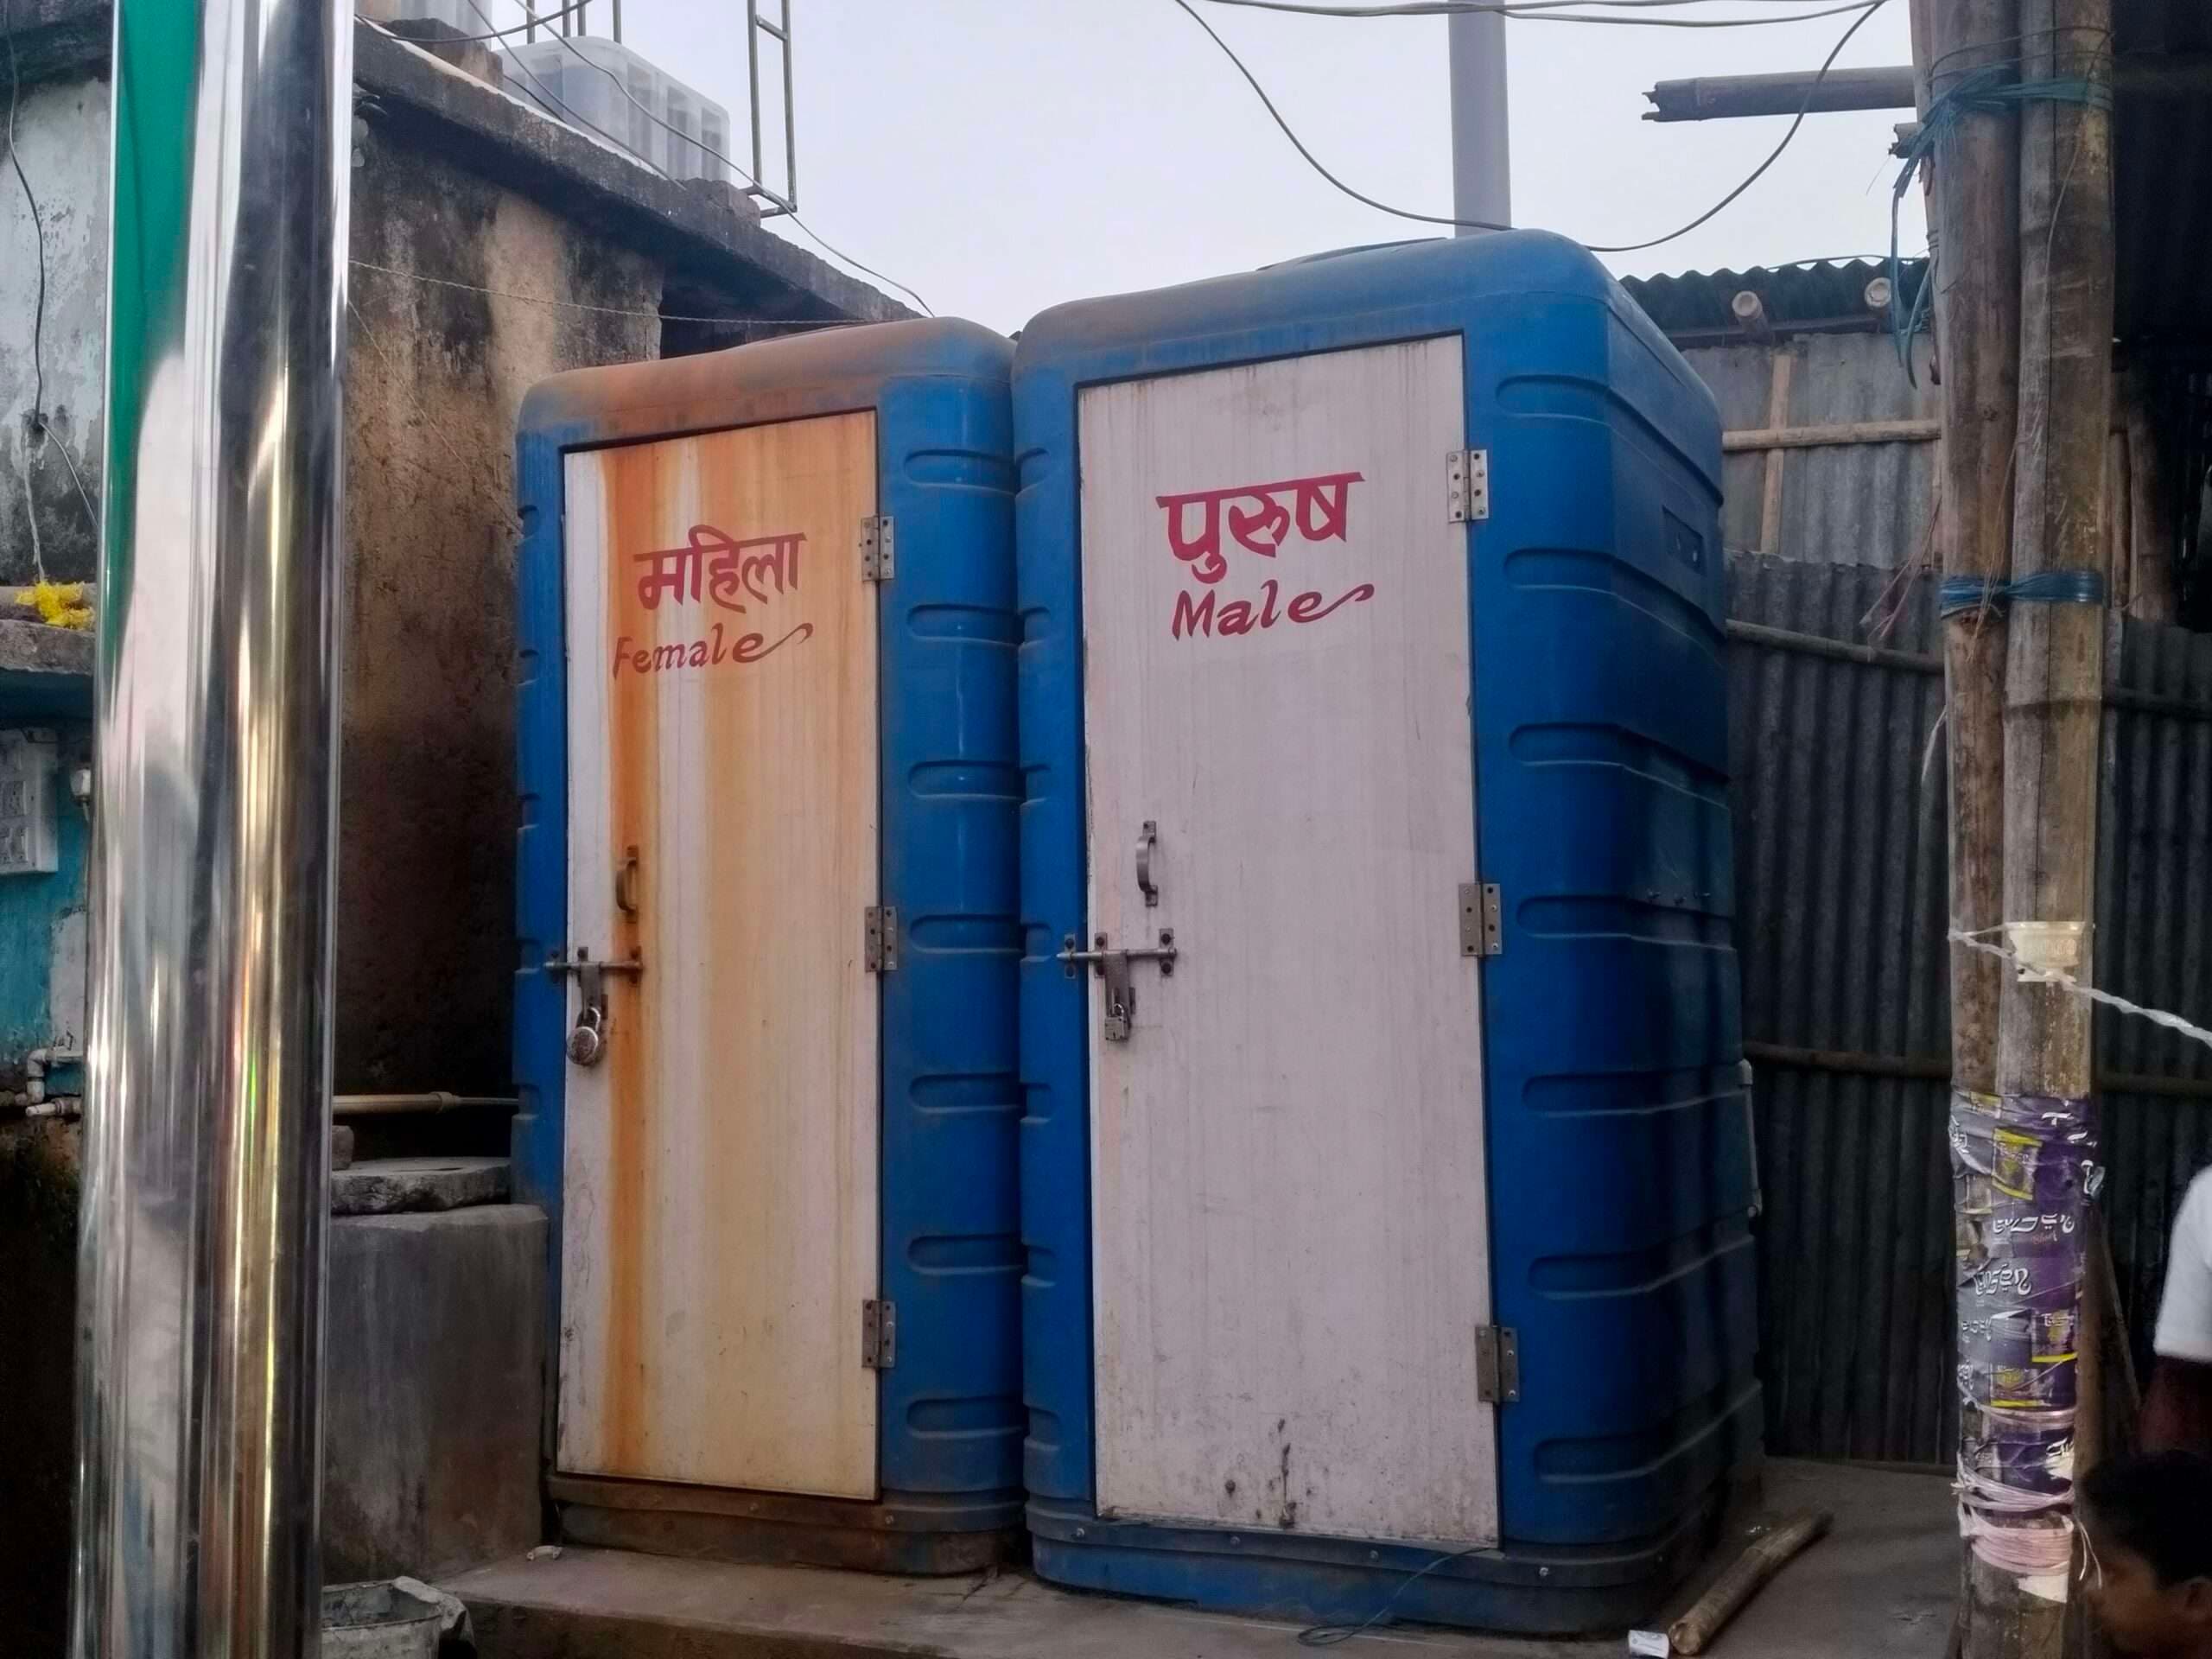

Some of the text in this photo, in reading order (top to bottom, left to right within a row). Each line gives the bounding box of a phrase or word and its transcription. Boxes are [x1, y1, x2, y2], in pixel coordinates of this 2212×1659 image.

[1155, 472, 1365, 584] पुरुष
[633, 524, 807, 614] महिला
[1172, 579, 1375, 641] Male
[613, 622, 814, 680] Female
